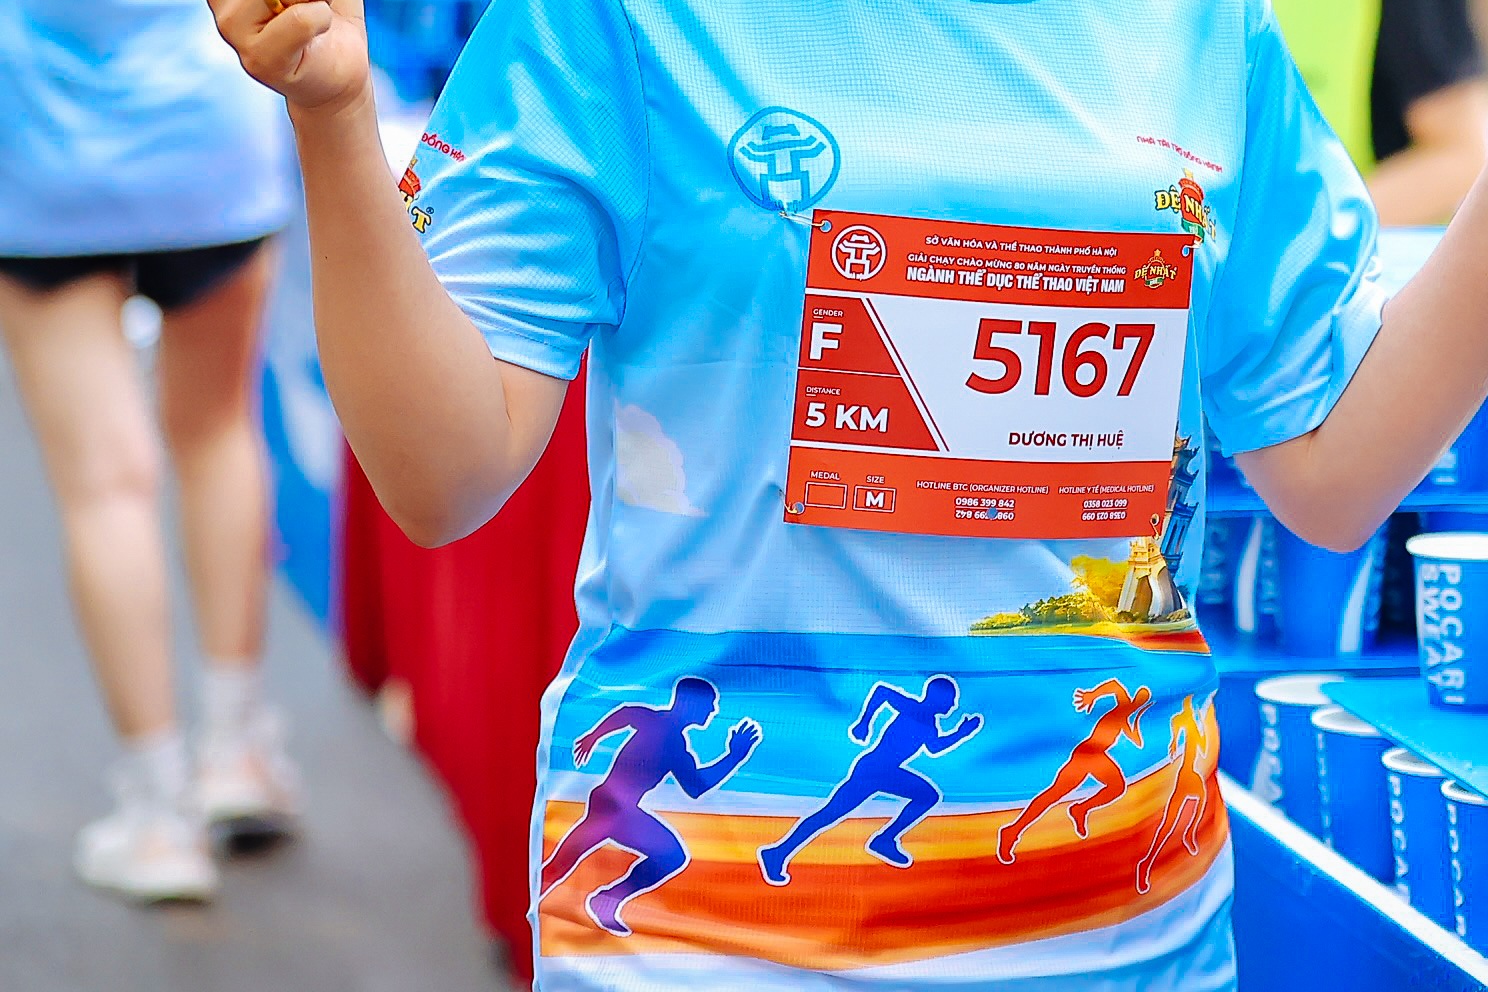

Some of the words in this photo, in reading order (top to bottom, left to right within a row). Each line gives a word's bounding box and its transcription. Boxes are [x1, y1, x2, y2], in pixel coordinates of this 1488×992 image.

[421, 132, 450, 154] ĐỒNG
[941, 237, 960, 247] VĂN
[963, 239, 983, 249] HÓA
[985, 241, 998, 250] VÀ
[1019, 244, 1042, 253] THAO
[1044, 245, 1072, 254] THÀNH
[1074, 246, 1091, 256] PHỐ
[1092, 247, 1103, 256] HÀ
[1104, 248, 1117, 257] NỘI
[908, 252, 927, 262] GIẢI
[929, 256, 955, 266] CHẠY
[957, 257, 983, 267] CHÀO
[985, 259, 1012, 269] MỪNG
[1014, 262, 1025, 270] 80
[1027, 262, 1046, 272] NĂM
[1048, 263, 1070, 273] NGÀY
[1102, 265, 1127, 274] THỐNG
[907, 265, 954, 284] NGÀNH
[958, 269, 987, 286] THỂ
[986, 273, 1013, 291] DỤC
[1016, 273, 1043, 289] THỂ
[1042, 276, 1073, 291] THAO
[1075, 276, 1099, 295] VIỆT
[1100, 279, 1124, 293] NAM
[813, 309, 843, 317] GENDER
[809, 322, 842, 360] F
[965, 318, 1155, 397] 5167
[806, 386, 840, 396] DISTANCE
[805, 402, 826, 427] 5
[835, 404, 889, 432] KM
[1008, 431, 1067, 446] DƯƠNG
[1071, 433, 1093, 450] THỊ
[1097, 430, 1124, 449] HUỆ
[810, 471, 840, 480] MEDAL
[866, 476, 885, 484] SIZE
[916, 481, 951, 490] HOTLINE
[952, 483, 968, 491] BTC
[969, 483, 1016, 493] (ORGANIZER
[1016, 486, 1049, 494] HOTLINE)
[1099, 486, 1127, 494] (MEDICAL
[1127, 485, 1155, 493] HOTLINE)
[865, 491, 885, 508] M
[955, 497, 979, 506] 0986
[979, 499, 997, 507] 399
[997, 500, 1015, 508] 842
[1083, 500, 1100, 508] 0358
[1101, 500, 1113, 508] 023
[1114, 499, 1128, 507] 099
[1440, 564, 1465, 704] POCARI
